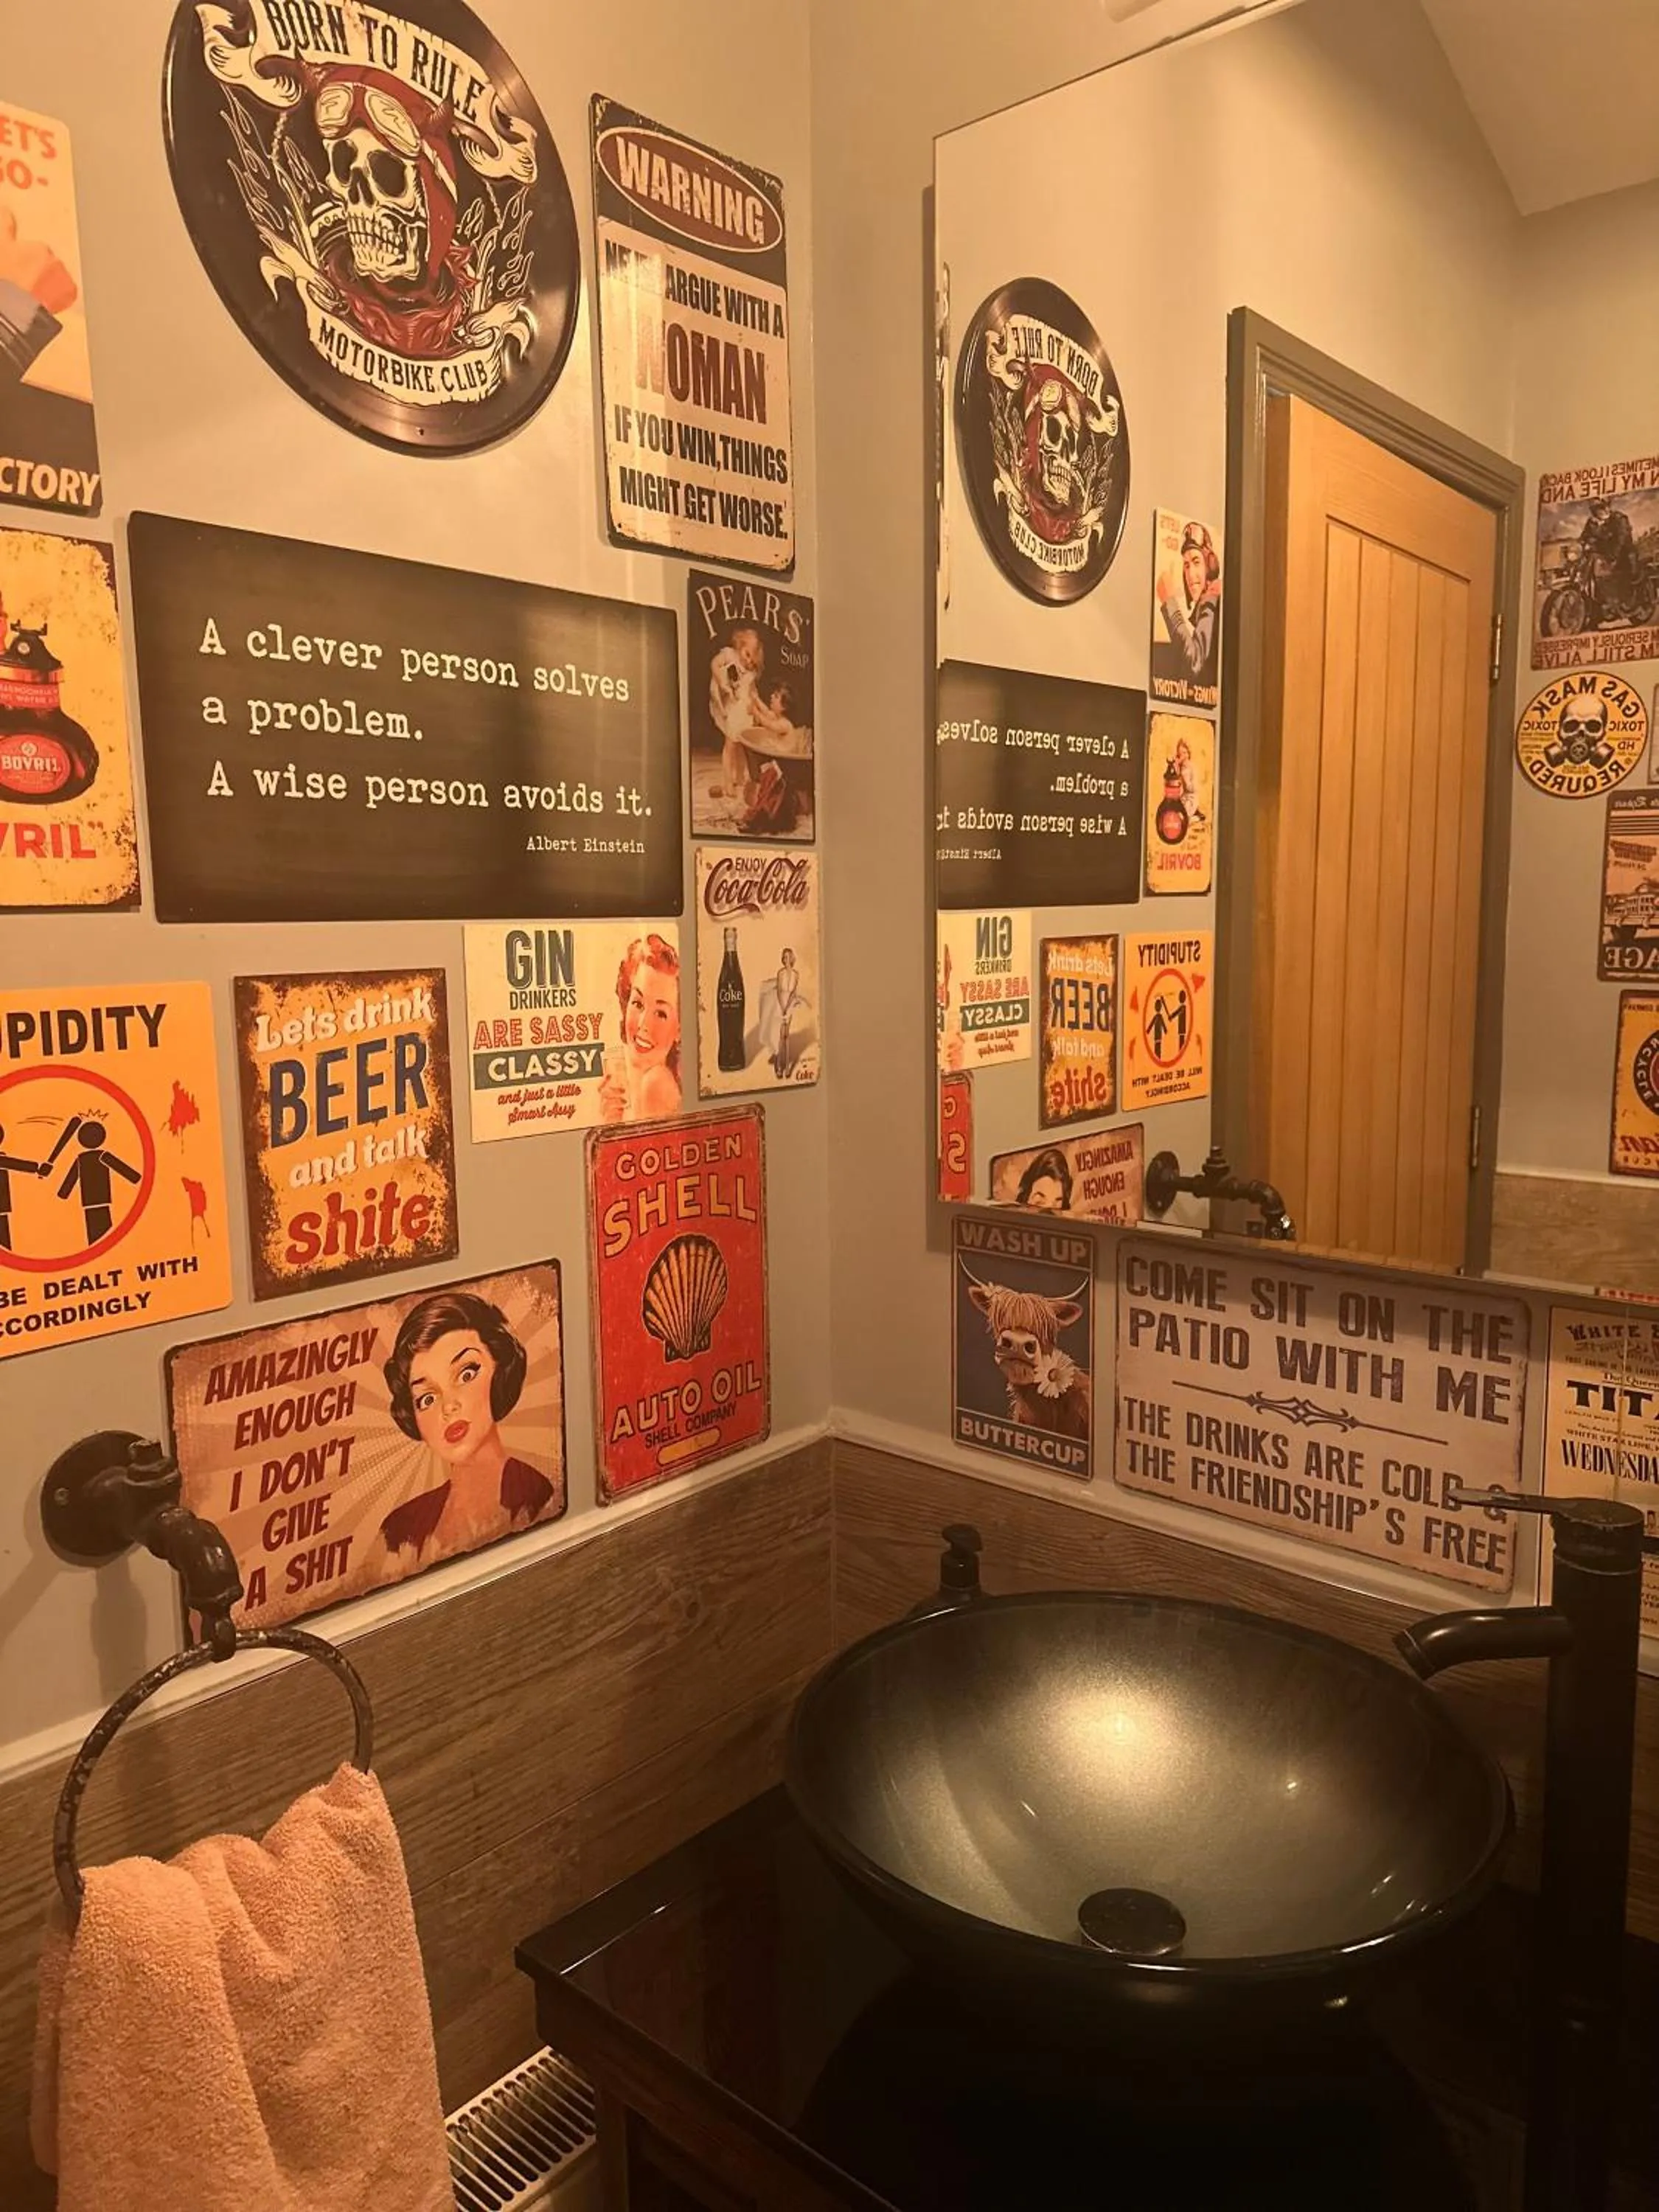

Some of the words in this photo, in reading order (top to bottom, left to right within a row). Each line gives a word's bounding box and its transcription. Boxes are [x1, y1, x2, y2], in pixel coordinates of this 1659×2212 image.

[263, 0, 349, 56] BORN
[359, 13, 397, 71] TO
[411, 36, 485, 122] RULE
[616, 135, 765, 244] WARNING
[665, 263, 722, 318] ARGUE
[724, 285, 770, 333] WITH
[773, 303, 785, 339] A
[319, 317, 435, 393] MOTORBIKE
[441, 359, 488, 393] CLUB
[614, 404, 632, 444] IF
[635, 410, 673, 456] YOU
[719, 434, 788, 484] THINGS
[619, 465, 680, 516] MIGHT
[684, 483, 716, 524] GET
[720, 492, 788, 539] WORSE.
[199, 617, 227, 657] A
[246, 622, 383, 671] clever
[400, 646, 519, 688] person
[532, 664, 630, 702] solves
[201, 695, 227, 726] a
[247, 697, 424, 740] problem.
[1, 754, 61, 773] BOVRIL
[207, 759, 234, 798] A
[253, 763, 348, 800] wise
[366, 773, 490, 810] person
[504, 782, 605, 815] avoids
[615, 785, 653, 818] it.
[526, 836, 577, 852] Albert
[582, 837, 645, 855] Einstein
[735, 857, 767, 872] ENJOY
[704, 858, 808, 917] Coca-Cola
[505, 930, 576, 990] GIN
[255, 1006, 338, 1053] Lets
[344, 987, 436, 1034] drink
[509, 988, 577, 1011] DRINKERS
[0, 1004, 167, 1059] PIDITY
[473, 1018, 523, 1050] ARE
[529, 1012, 604, 1046] SASSY
[269, 1032, 429, 1149] BEER
[487, 1048, 597, 1082] CLASSY
[498, 1089, 521, 1105] and
[520, 1087, 544, 1106] just
[546, 1089, 554, 1099] a
[288, 1139, 358, 1188] and
[364, 1125, 429, 1167] talk
[615, 1133, 742, 1180] GOLDEN
[285, 1180, 431, 1265] shite
[603, 1172, 758, 1259] SHELL
[961, 1221, 1043, 1257] WASH
[1050, 1239, 1088, 1264] UP
[44, 1268, 123, 1300] DEALT
[136, 1256, 198, 1282] WITH
[0, 1291, 150, 1339] CORDINGLY
[1126, 1256, 1227, 1313] COME
[1251, 1277, 1314, 1328] SIT
[1338, 1291, 1394, 1343] ON
[1422, 1304, 1514, 1364] THE
[1565, 1324, 1641, 1341] WHITE
[204, 1328, 378, 1406] AMAZINGLY
[1129, 1307, 1250, 1370] PATIO
[1276, 1335, 1405, 1403] WITH
[1436, 1366, 1511, 1425] ME
[234, 1381, 356, 1450] ENOUGH
[611, 1378, 703, 1444] AUTO
[711, 1360, 762, 1404] OIL
[644, 1421, 680, 1450] SHELL
[685, 1401, 737, 1435] COMPANY
[1566, 1379, 1659, 1420] TIT
[961, 1416, 1087, 1467] BUTTERCUP
[1124, 1396, 1171, 1440] THE
[1186, 1411, 1289, 1470] DRINKS
[1304, 1440, 1365, 1489] ARE
[1382, 1459, 1463, 1512] COLD
[229, 1470, 243, 1512] I
[259, 1436, 355, 1503] DON'T
[262, 1492, 332, 1552] GIVE
[1127, 1439, 1175, 1484] THE
[1192, 1455, 1405, 1545] FRIENDSHIP'S
[1423, 1516, 1506, 1575] FREE
[244, 1565, 267, 1613] A
[285, 1536, 353, 1594] SHIT
